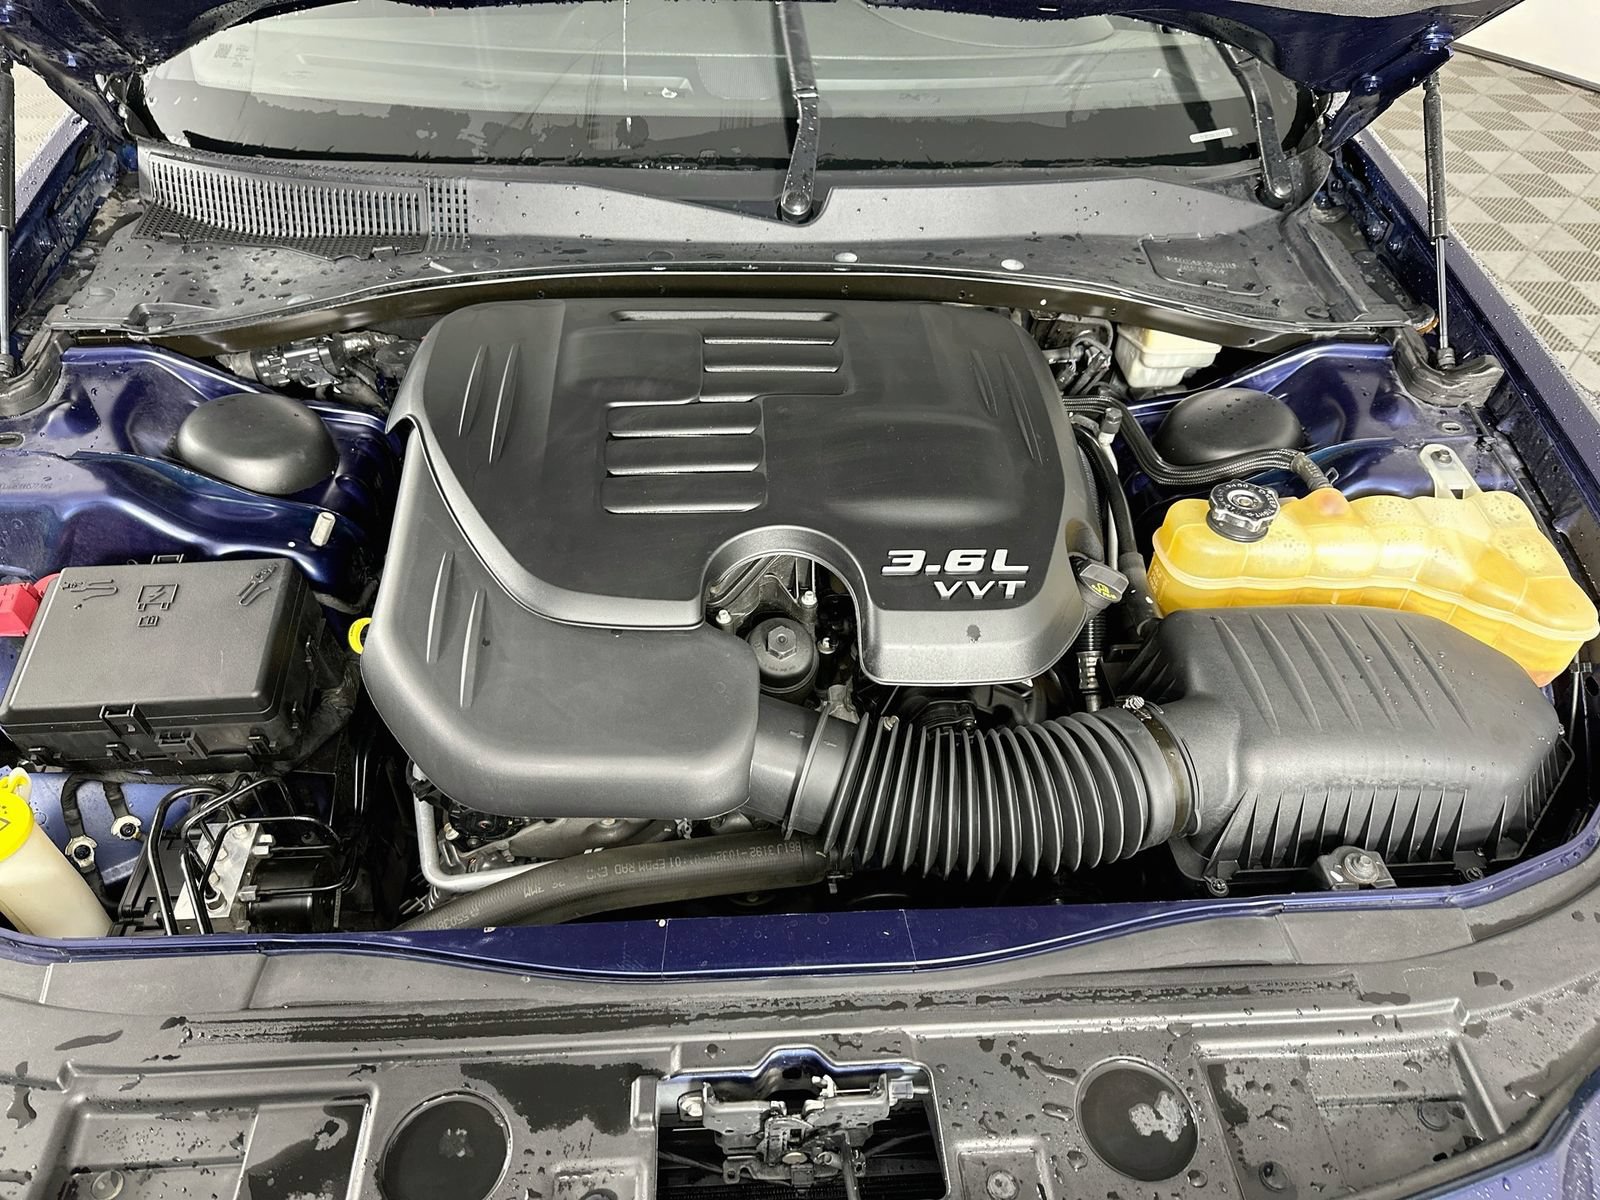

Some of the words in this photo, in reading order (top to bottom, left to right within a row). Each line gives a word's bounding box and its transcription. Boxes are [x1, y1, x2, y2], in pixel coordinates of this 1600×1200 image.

[881, 549, 1029, 576] 3.6L
[934, 581, 1026, 600] VVT
[615, 861, 637, 874] RAD
